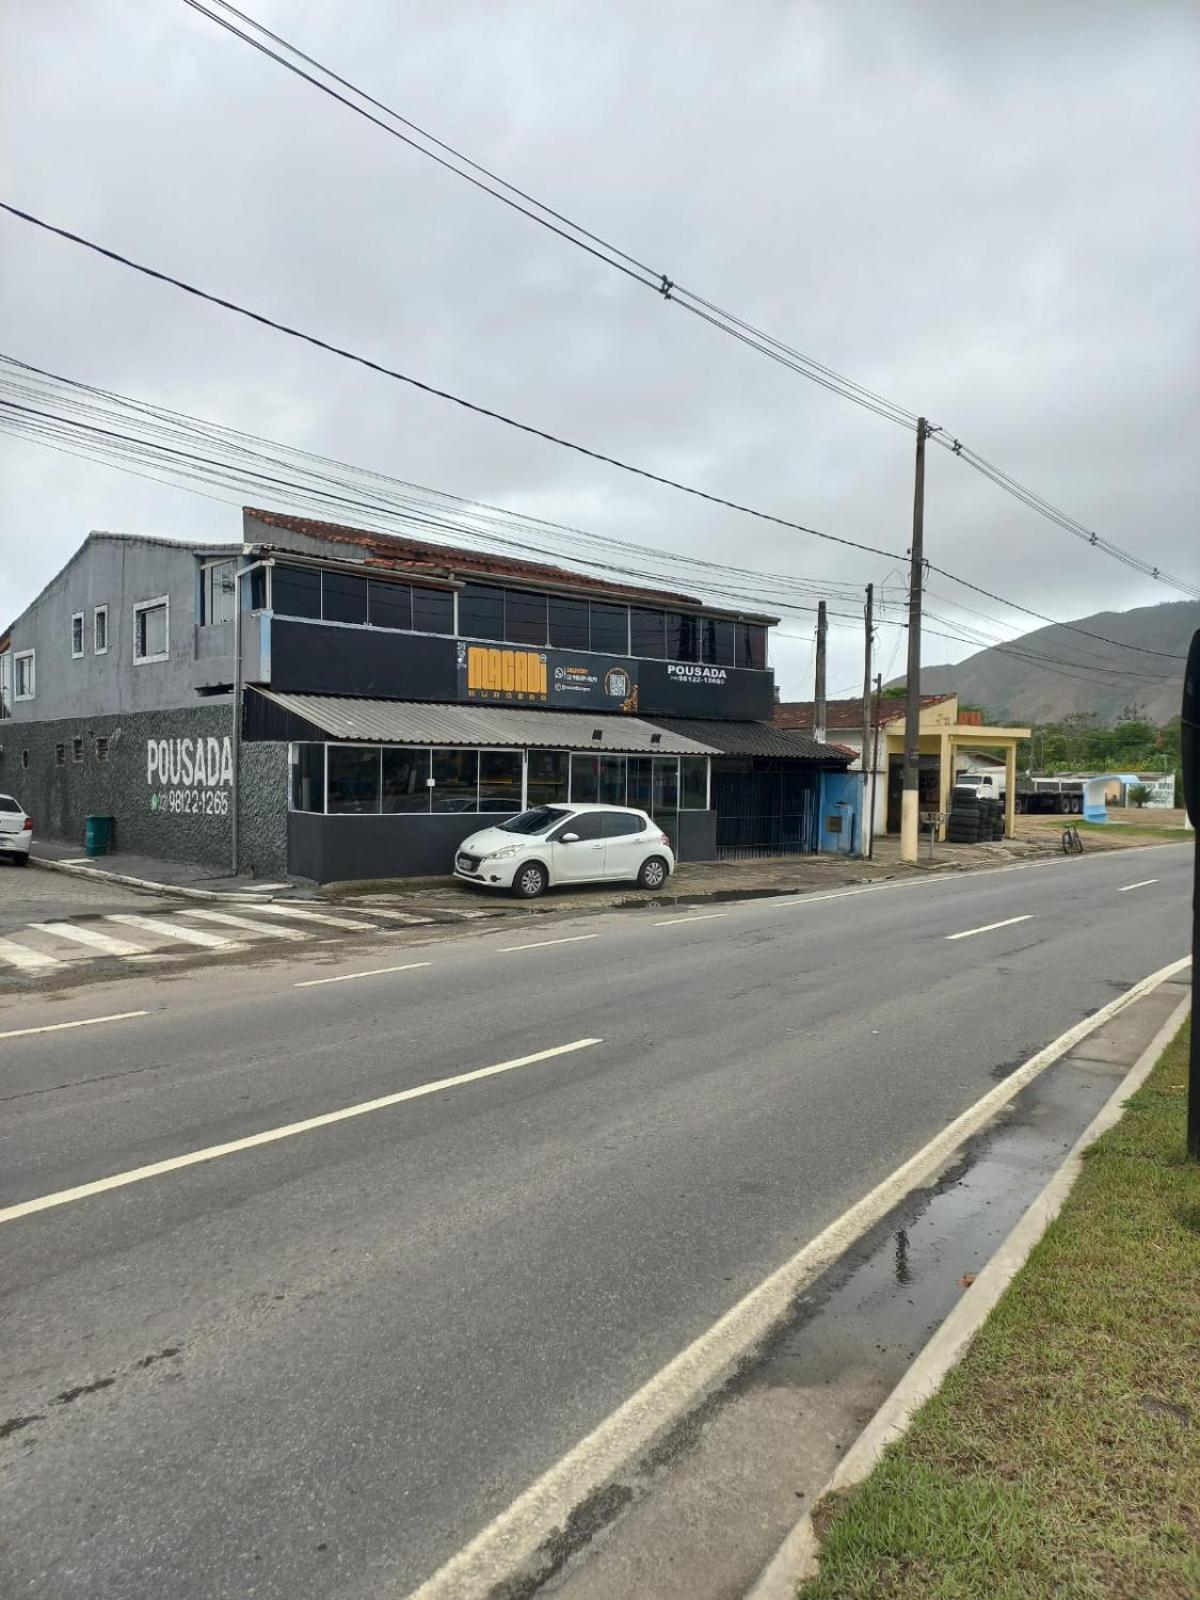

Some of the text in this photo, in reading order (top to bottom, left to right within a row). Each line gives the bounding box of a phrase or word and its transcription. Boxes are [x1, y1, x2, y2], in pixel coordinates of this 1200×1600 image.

[667, 665, 727, 679] POUSADA
[147, 736, 233, 786] POUSADA
[169, 789, 228, 815] 98122-1265
